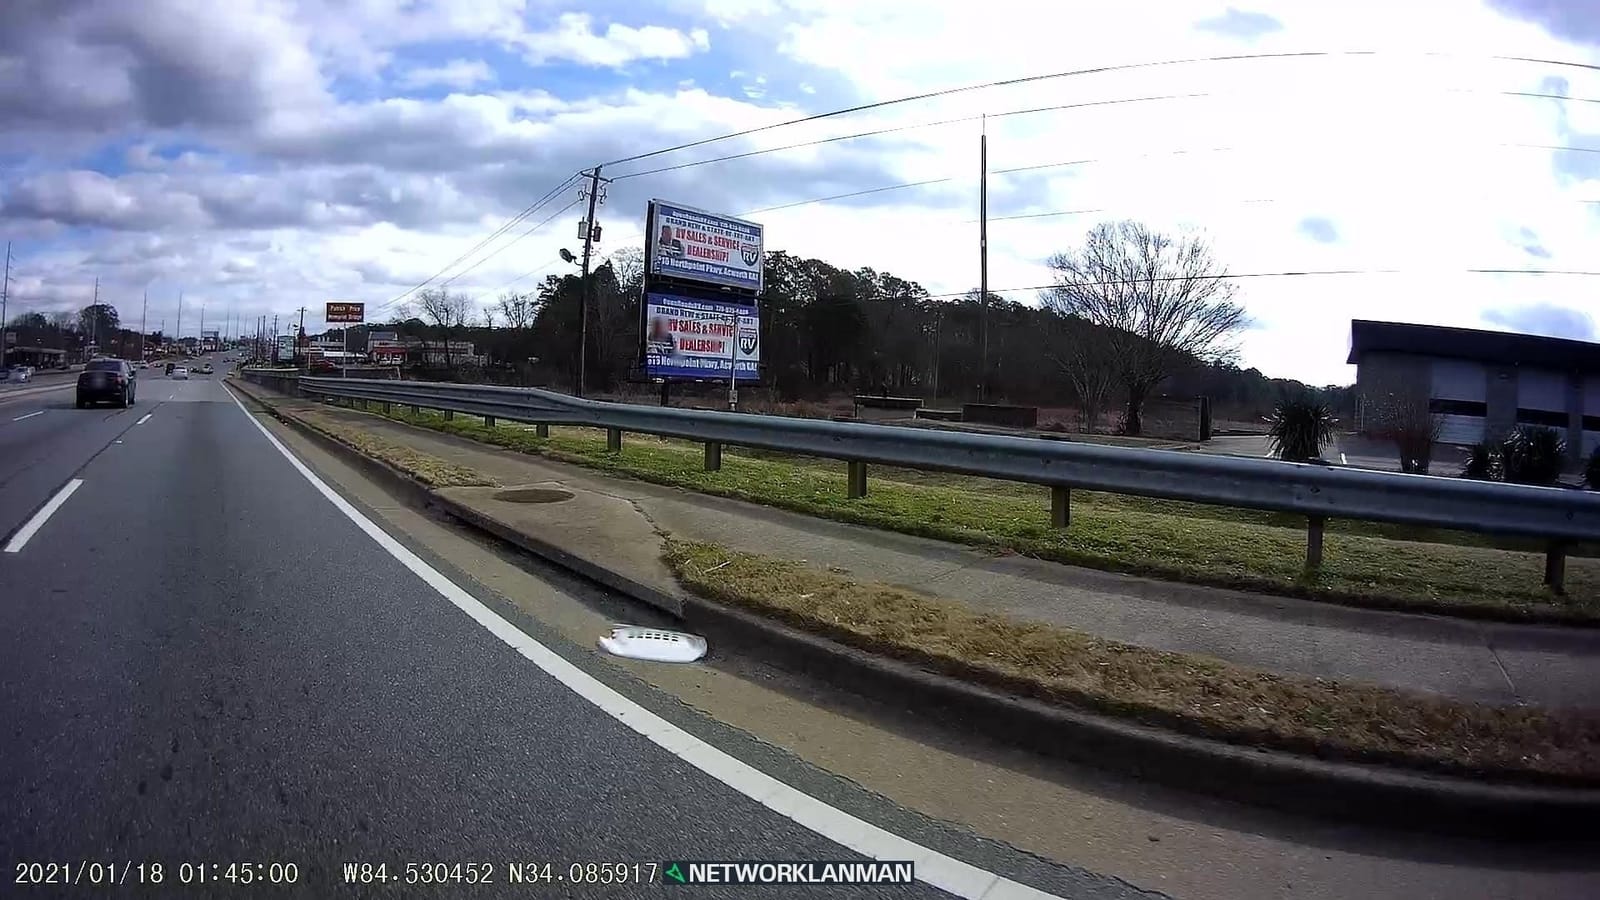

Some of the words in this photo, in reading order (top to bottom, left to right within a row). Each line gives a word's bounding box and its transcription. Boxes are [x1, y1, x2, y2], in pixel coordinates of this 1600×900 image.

[676, 228, 686, 239] RV
[686, 229, 707, 244] SALES
[707, 236, 713, 244] &
[713, 236, 740, 250] SERVICE
[743, 251, 757, 262] RV
[670, 258, 705, 271] Northpoint
[655, 306, 679, 316] BRAND
[668, 319, 678, 331] RV
[679, 320, 701, 334] SALES
[702, 324, 708, 334] &
[709, 323, 738, 337] SERVIC
[740, 338, 756, 350] RV
